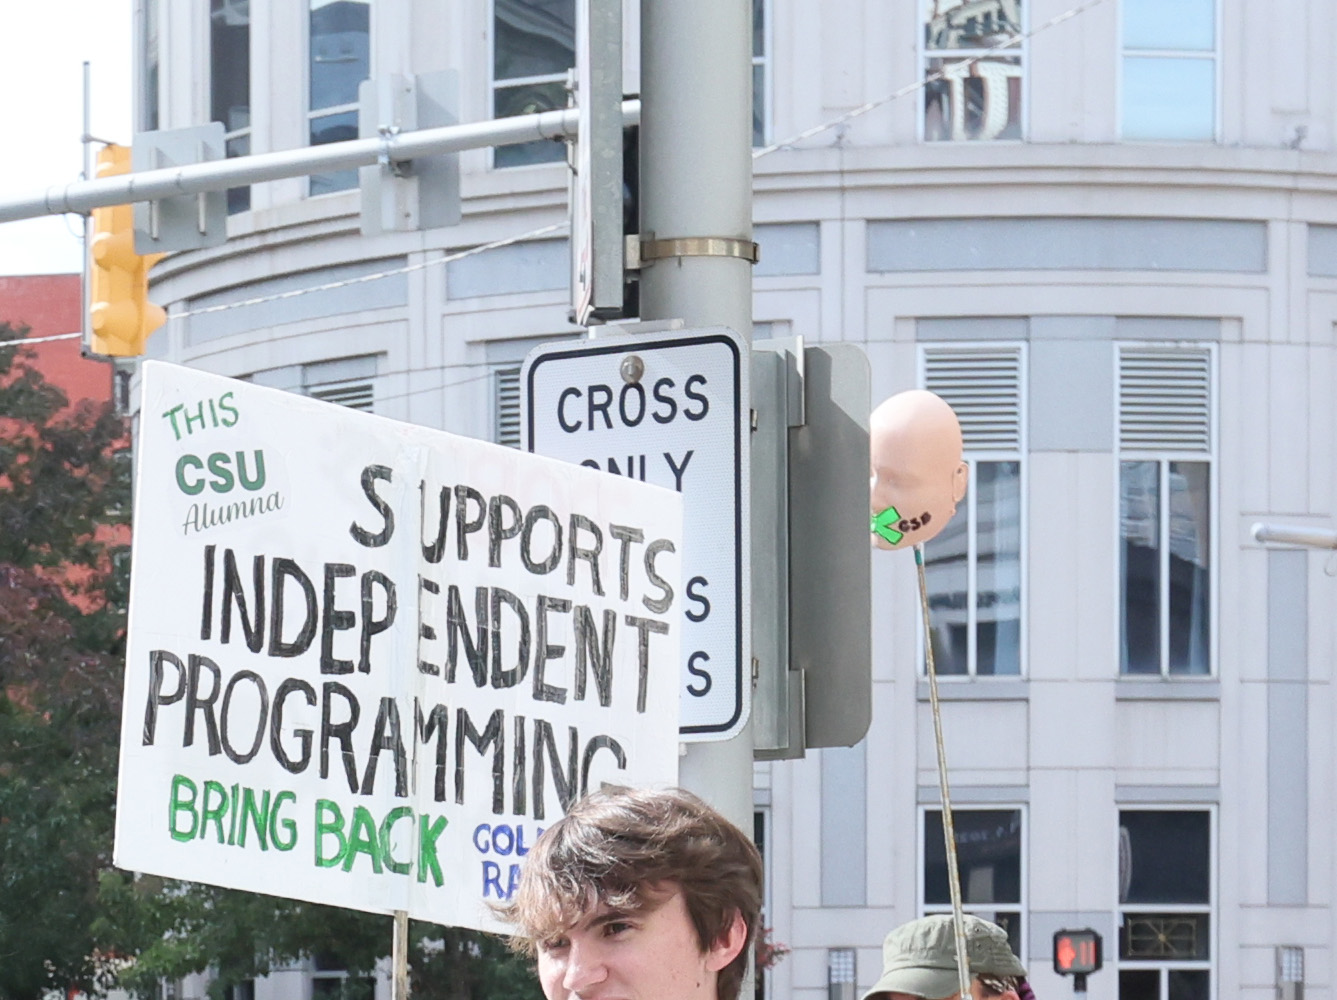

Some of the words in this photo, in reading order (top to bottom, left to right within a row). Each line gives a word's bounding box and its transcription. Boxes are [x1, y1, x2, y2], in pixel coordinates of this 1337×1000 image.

[162, 392, 239, 441] THIS
[557, 373, 710, 434] CROSS
[175, 450, 266, 496] CSU
[181, 490, 284, 536] Alumna
[350, 463, 676, 614] SUPPORTS
[200, 544, 670, 714] INDEPENDENT
[168, 773, 298, 852] BRING
[315, 798, 448, 888] BACK
